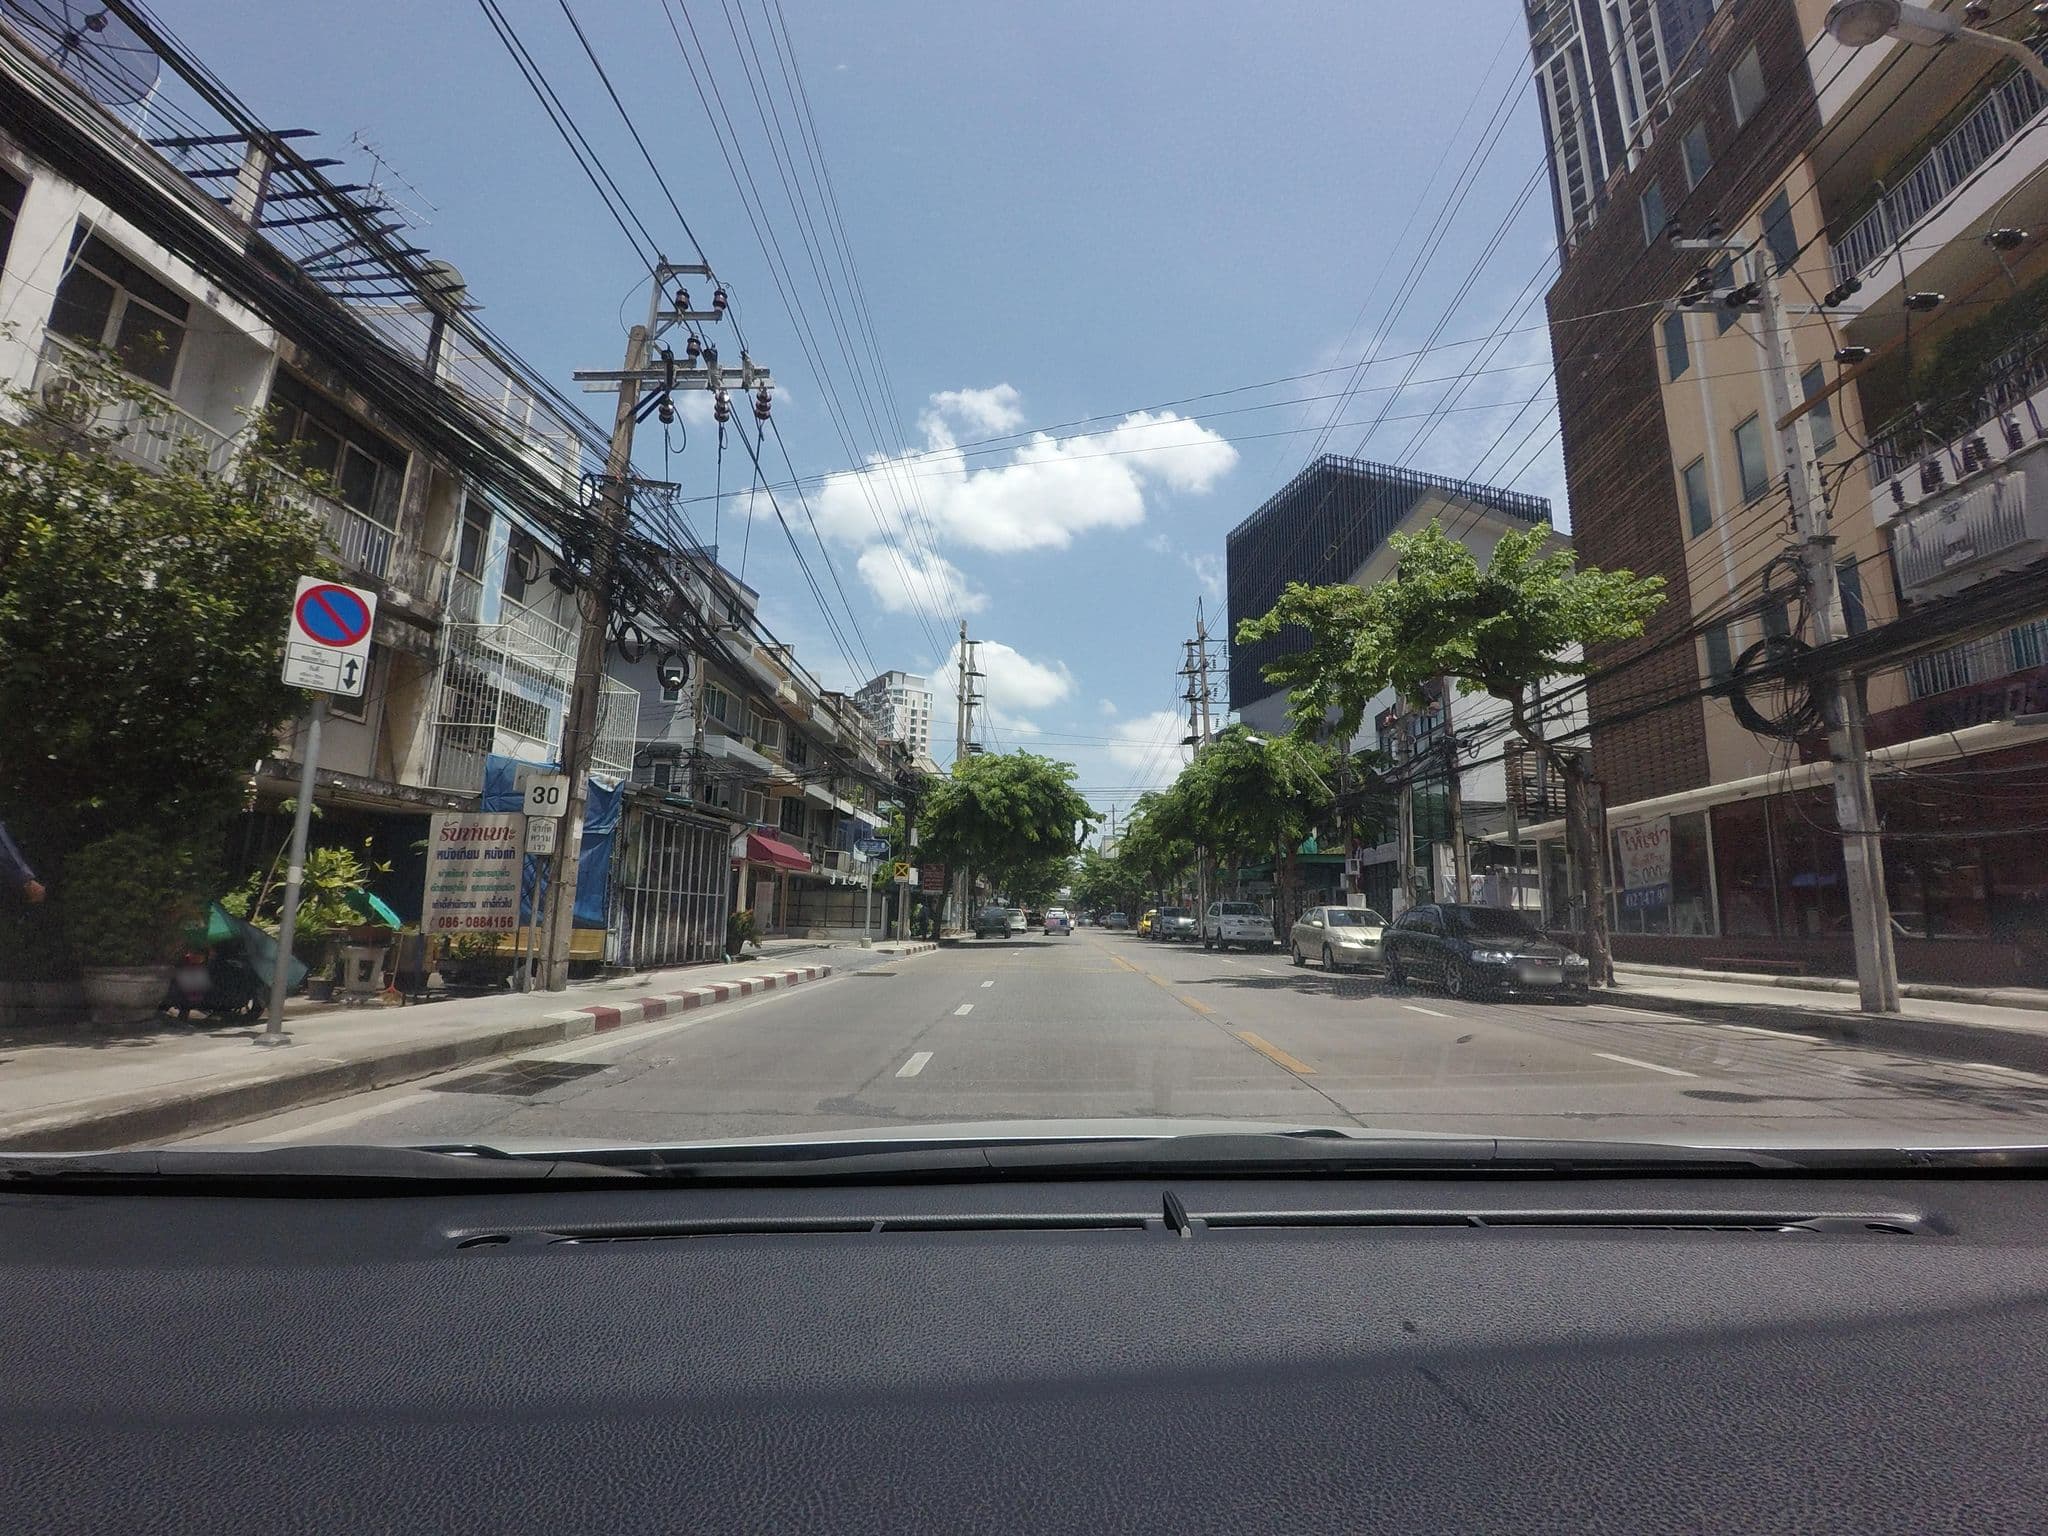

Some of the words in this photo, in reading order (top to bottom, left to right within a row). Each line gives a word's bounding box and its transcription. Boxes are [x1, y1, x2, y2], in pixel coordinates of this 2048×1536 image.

[532, 786, 559, 804] 30
[440, 821, 516, 841] รับทำเบาะ
